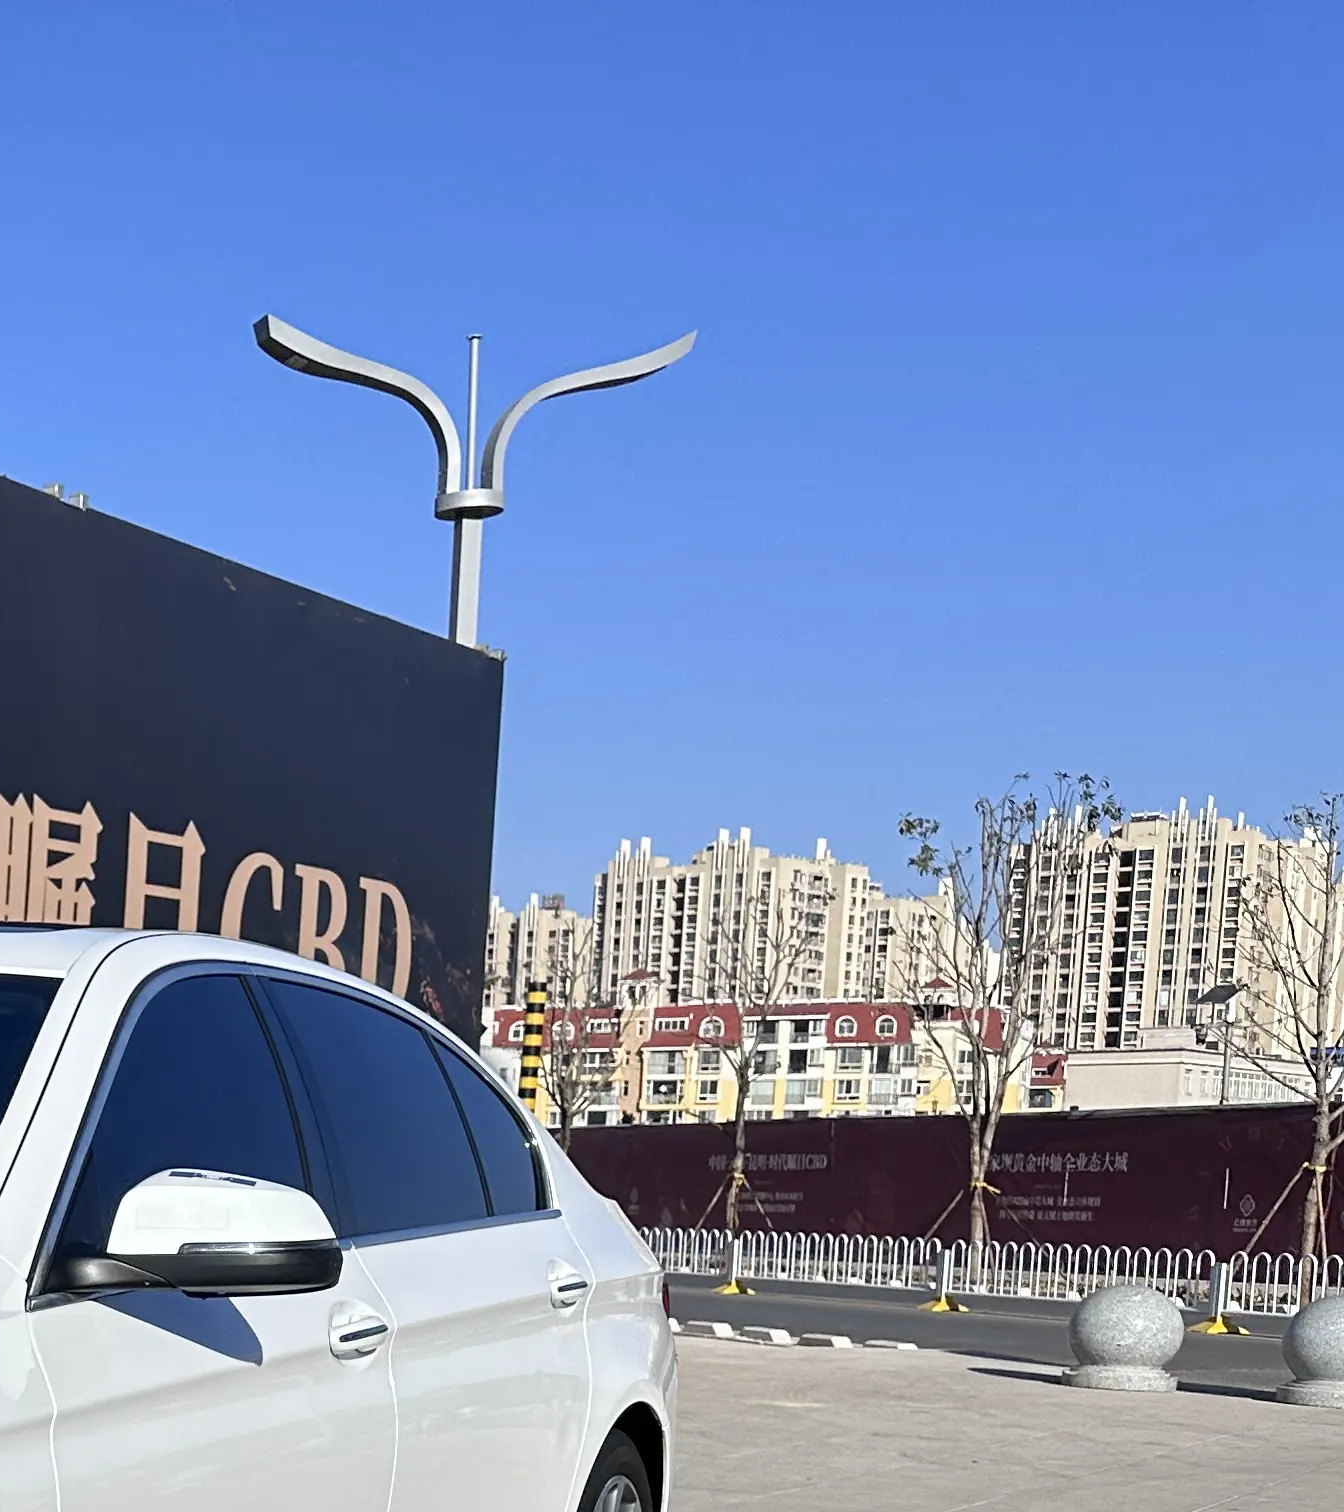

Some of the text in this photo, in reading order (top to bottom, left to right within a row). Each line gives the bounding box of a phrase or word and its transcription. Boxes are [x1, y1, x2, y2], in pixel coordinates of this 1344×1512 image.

[985, 1151, 1128, 1172] 家坝黄金中轴全业态大城
